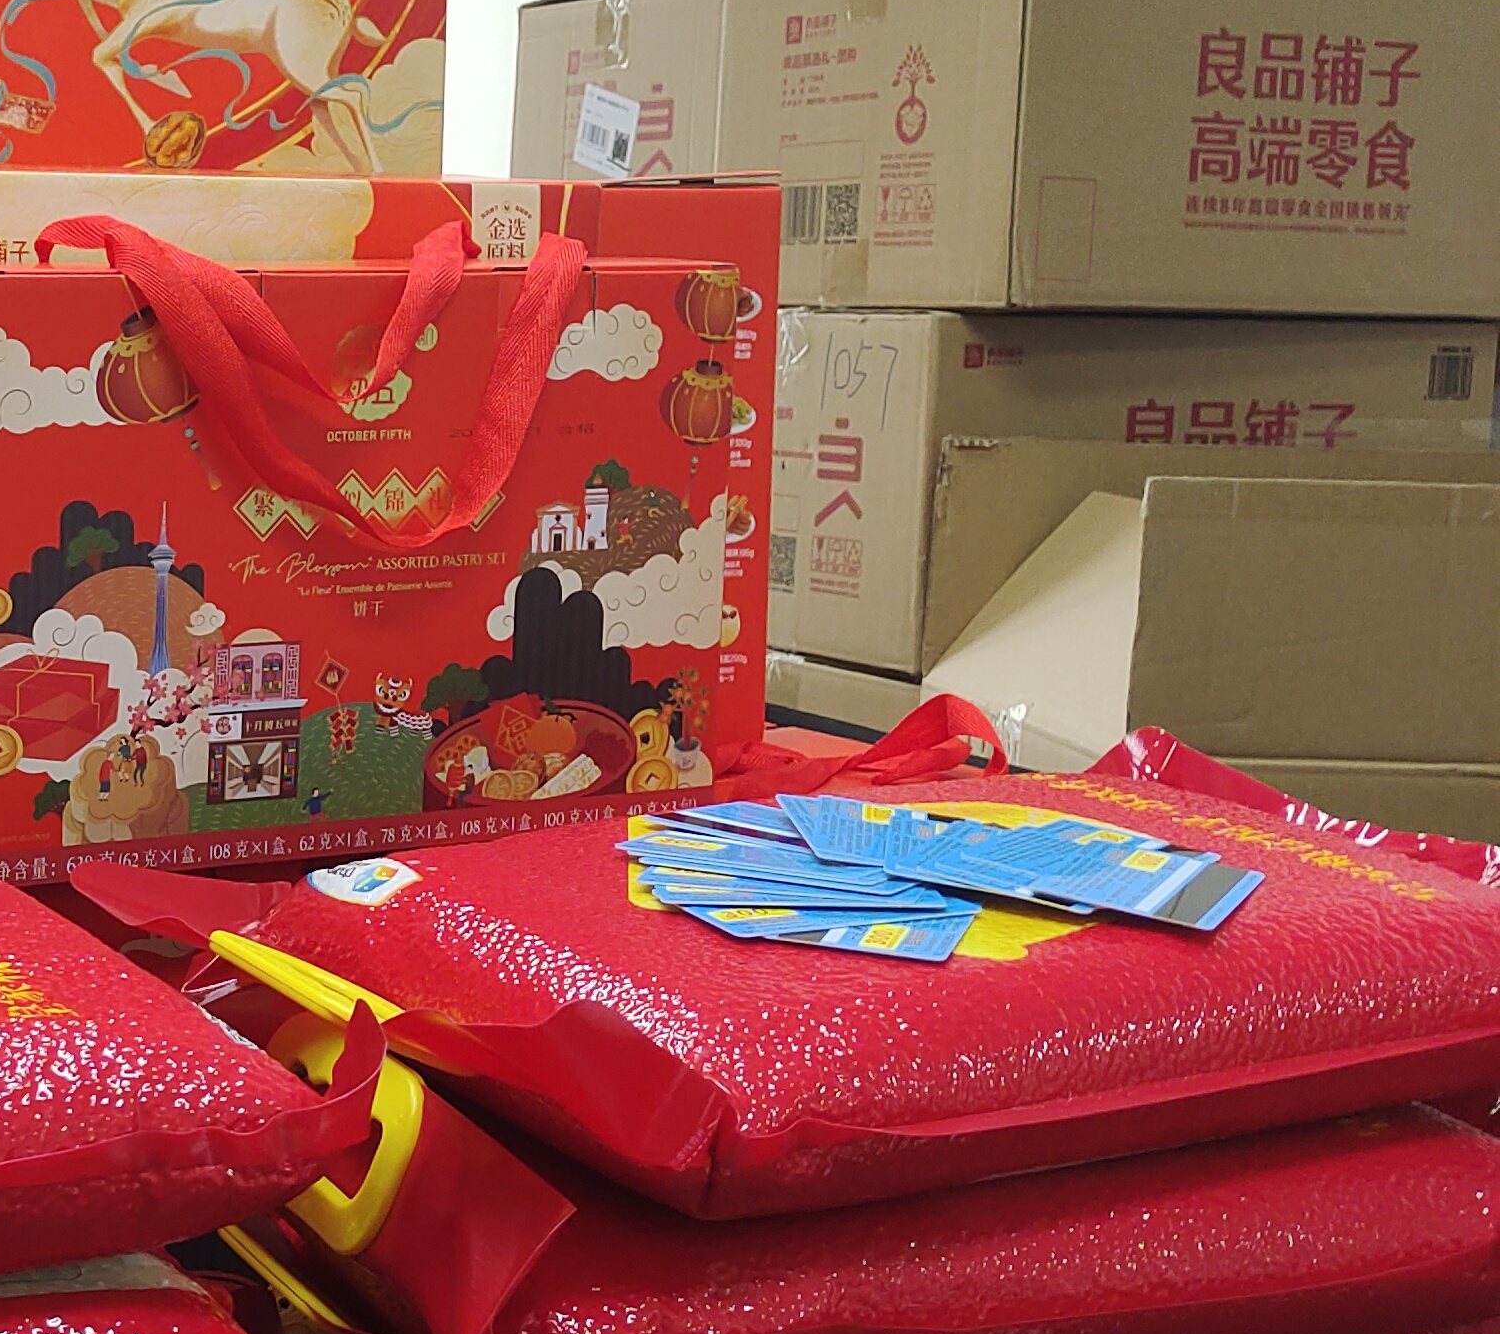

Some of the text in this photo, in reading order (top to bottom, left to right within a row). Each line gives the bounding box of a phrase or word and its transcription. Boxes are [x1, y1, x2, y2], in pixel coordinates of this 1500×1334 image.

[1196, 27, 1421, 108] 良品铺子
[1187, 110, 1415, 191] 高端零食
[486, 217, 527, 241] 金选
[820, 331, 898, 432] 1057
[326, 428, 412, 443] OCTOBER FIFTH
[375, 554, 440, 571] ASSORTED
[442, 553, 484, 570] PASTRY
[486, 551, 507, 566] SET
[352, 599, 386, 618] 饼干
[208, 843, 231, 860] 108
[299, 835, 316, 852] 62
[379, 828, 396, 843] 78
[459, 819, 481, 836] 108
[543, 810, 565, 828] 100
